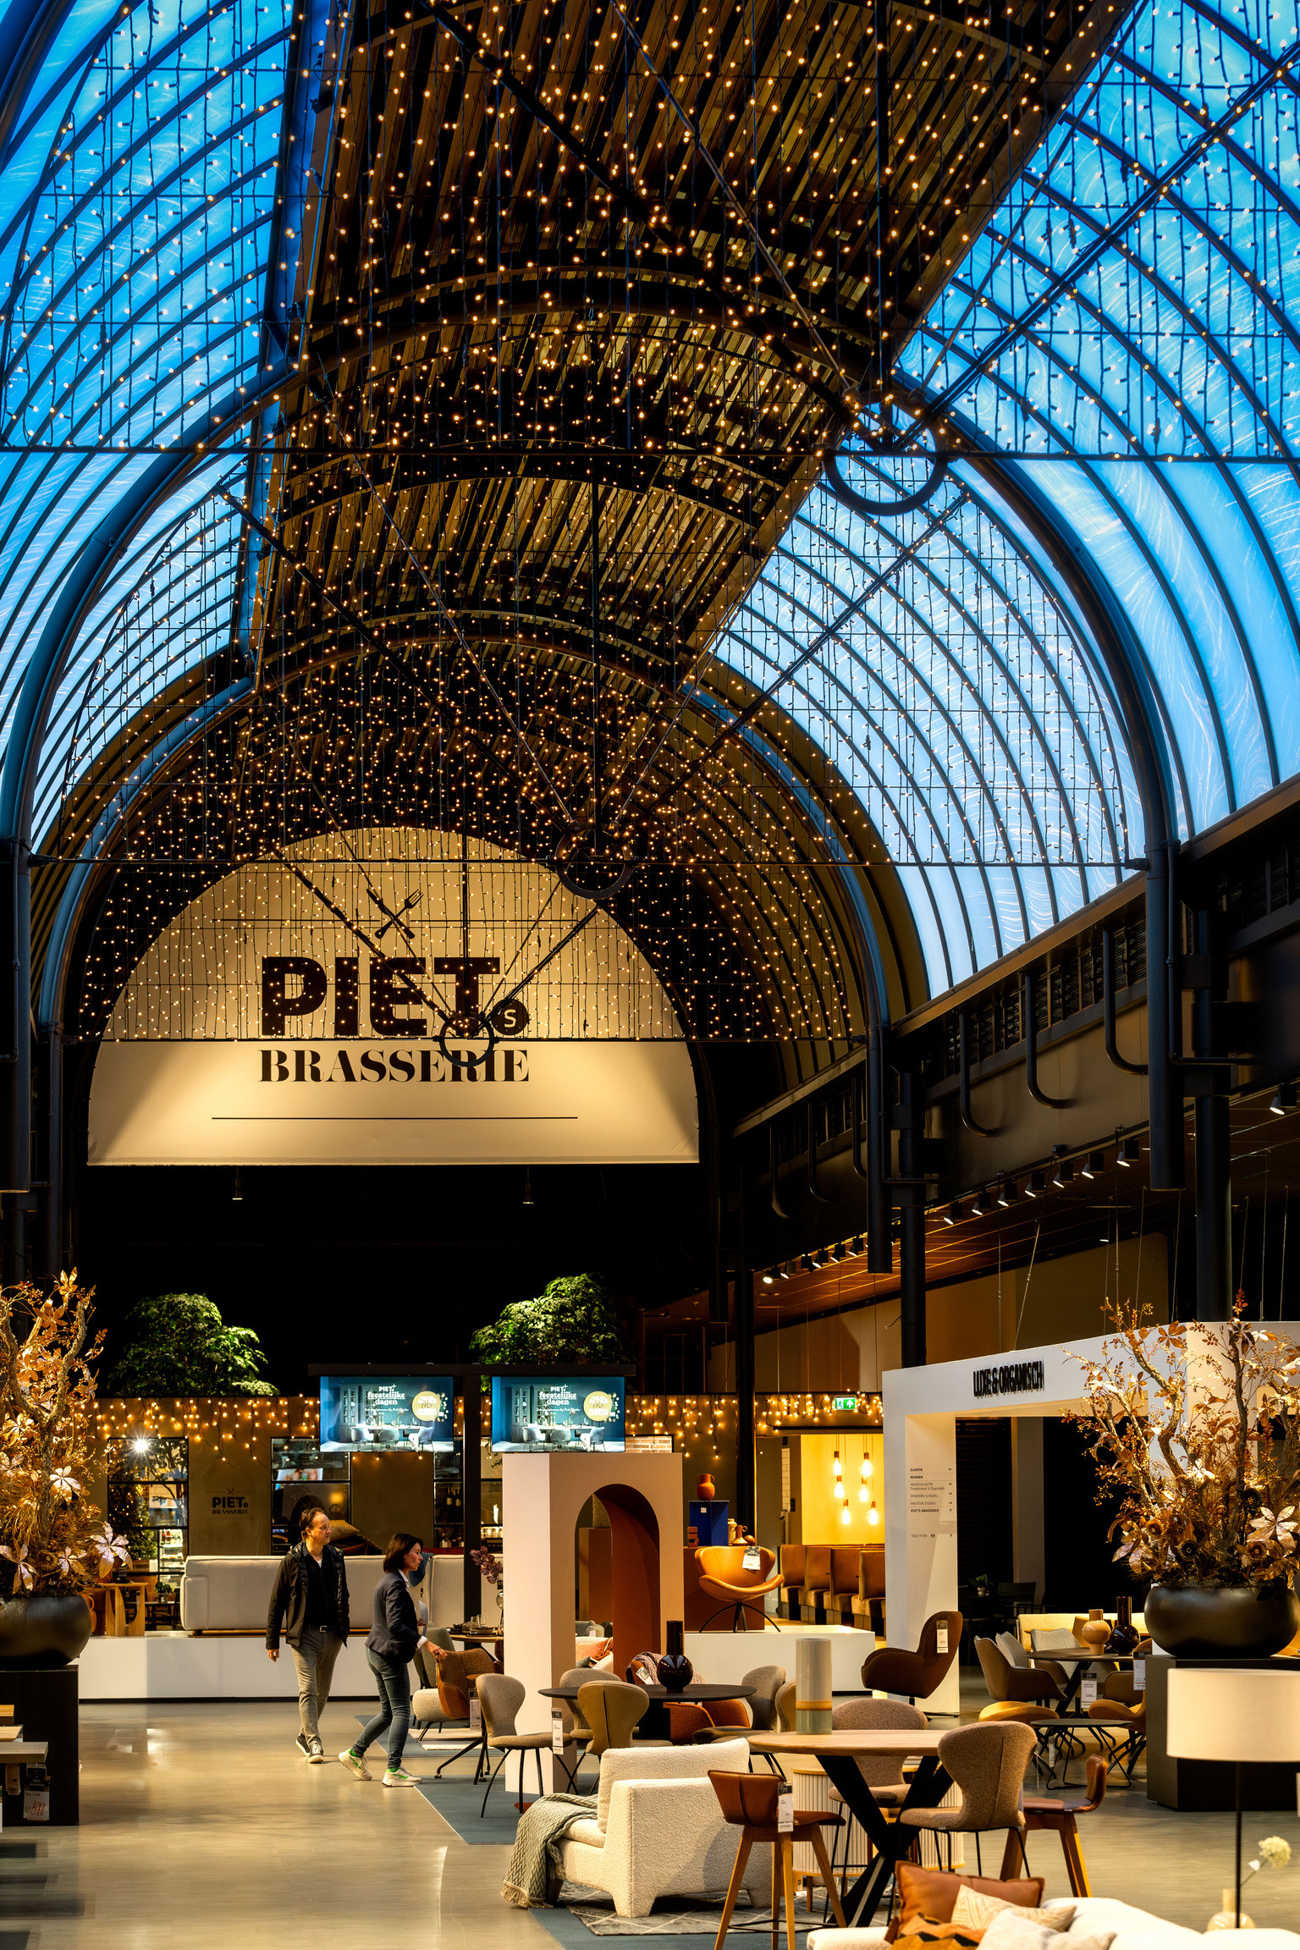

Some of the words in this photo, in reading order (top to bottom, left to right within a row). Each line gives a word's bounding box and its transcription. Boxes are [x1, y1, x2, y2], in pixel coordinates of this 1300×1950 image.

[259, 1049, 530, 1082] BRASSERIE
[973, 1369, 991, 1397] LUXE
[999, 1360, 1045, 1393] ORGANISCH
